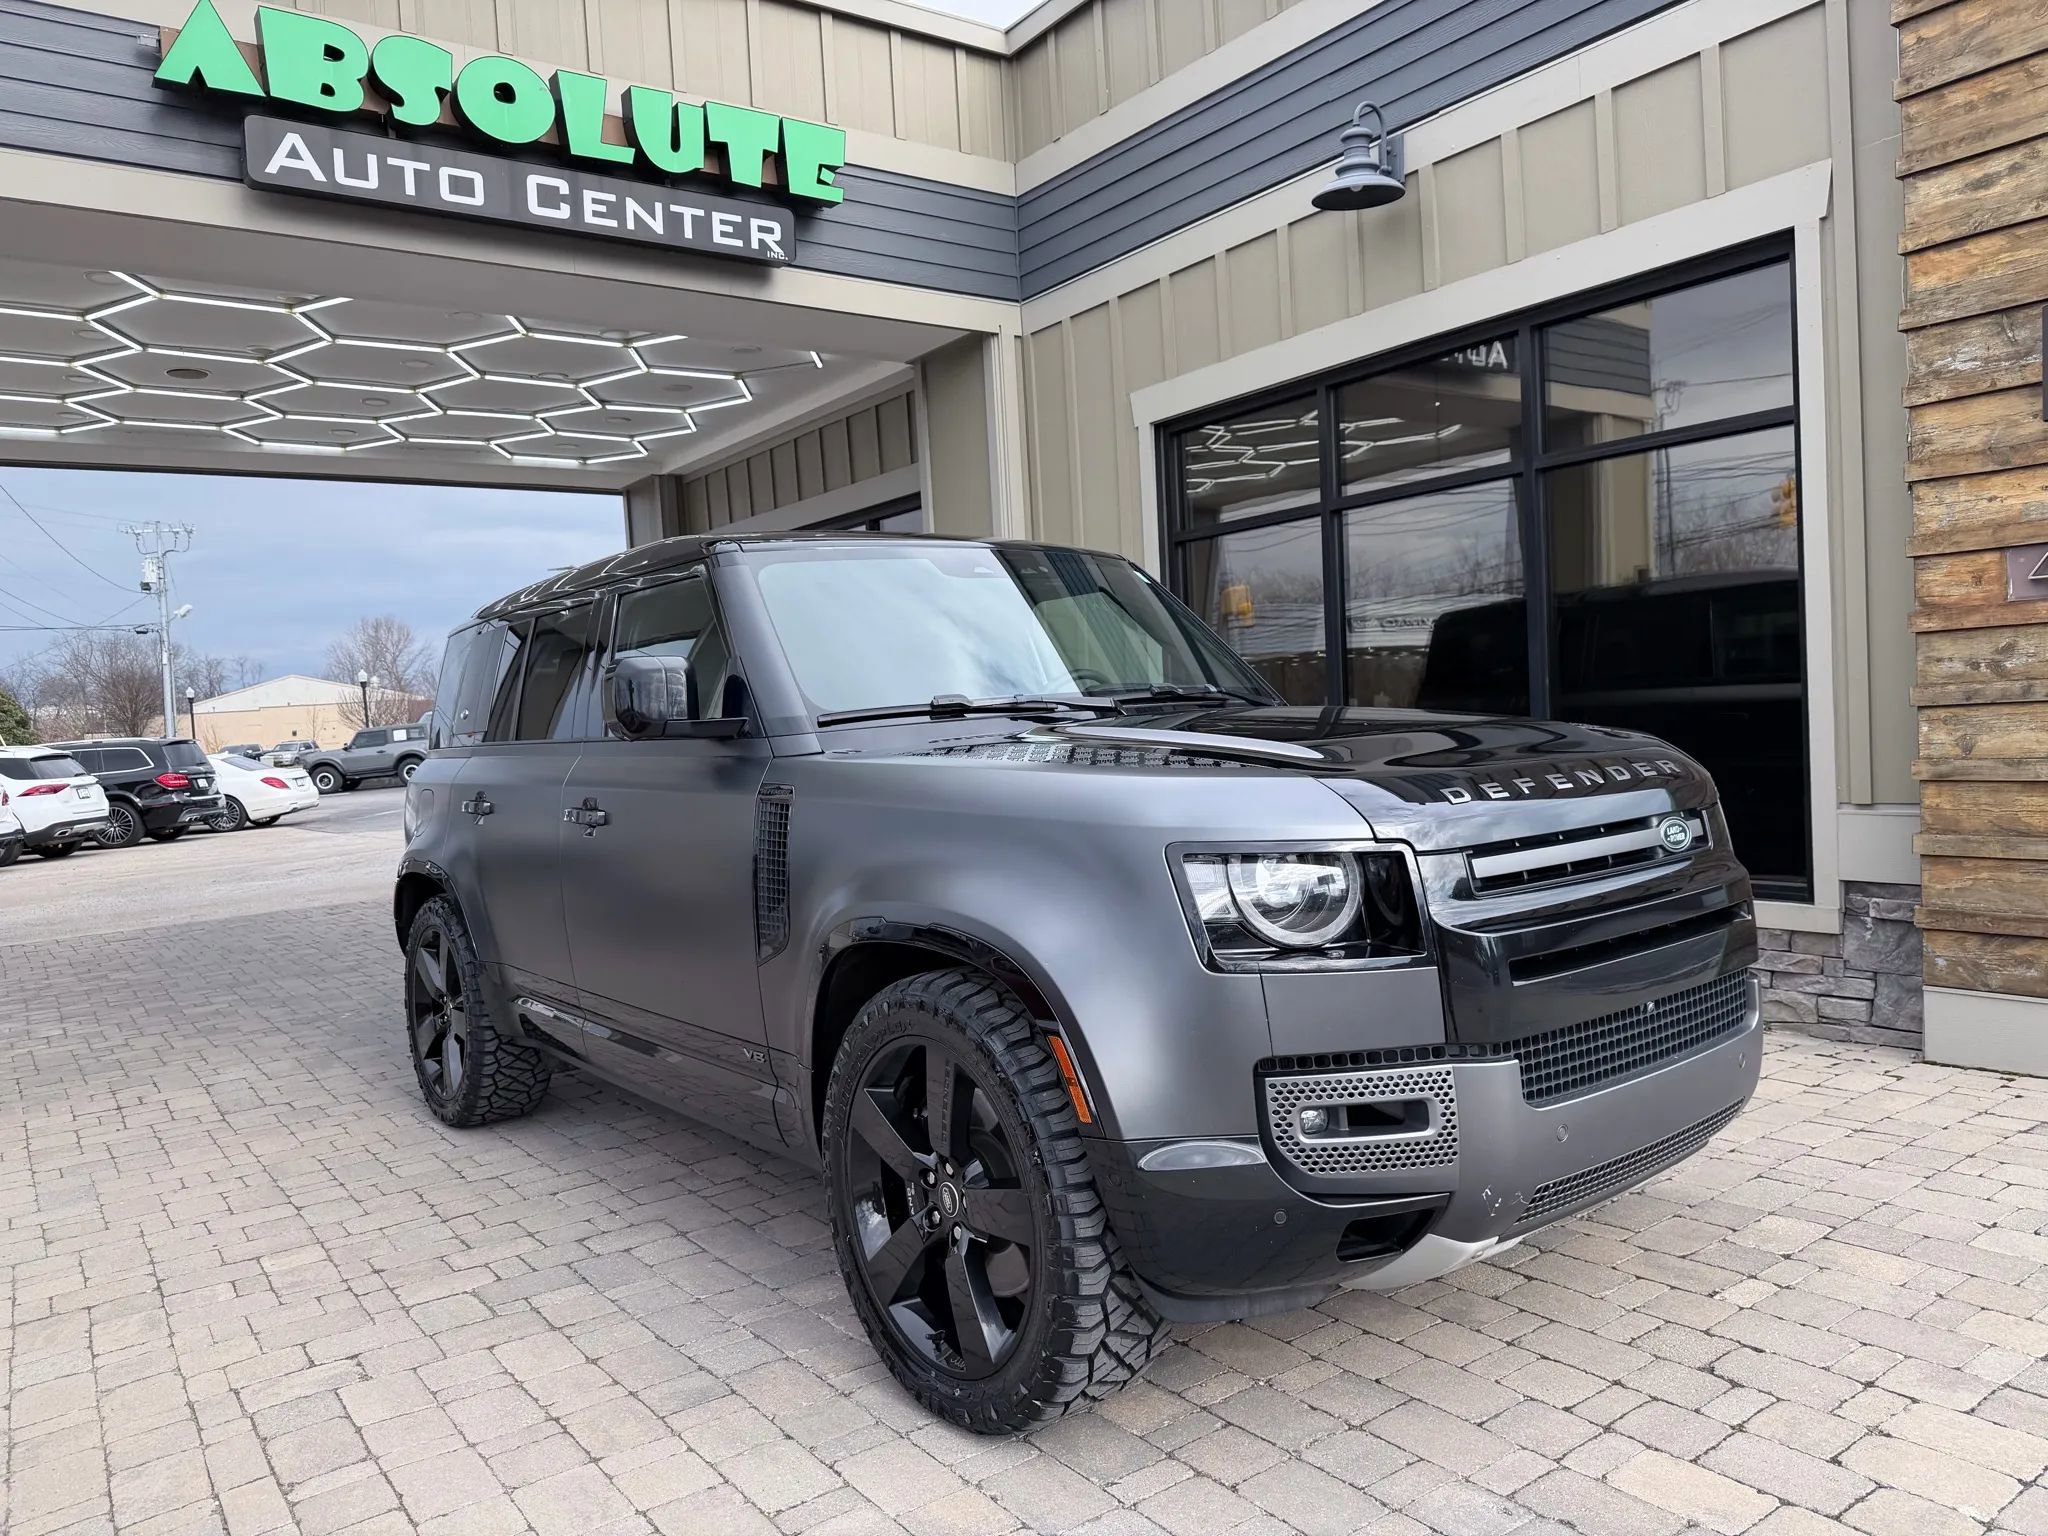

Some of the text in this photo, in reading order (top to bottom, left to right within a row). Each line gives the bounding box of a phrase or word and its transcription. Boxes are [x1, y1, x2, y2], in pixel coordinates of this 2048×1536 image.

[153, 0, 846, 204] ABSOLUTE
[264, 131, 784, 254] AUTO CENTER
[1439, 758, 1682, 805] DEFENDER
[743, 1047, 766, 1063] V8
